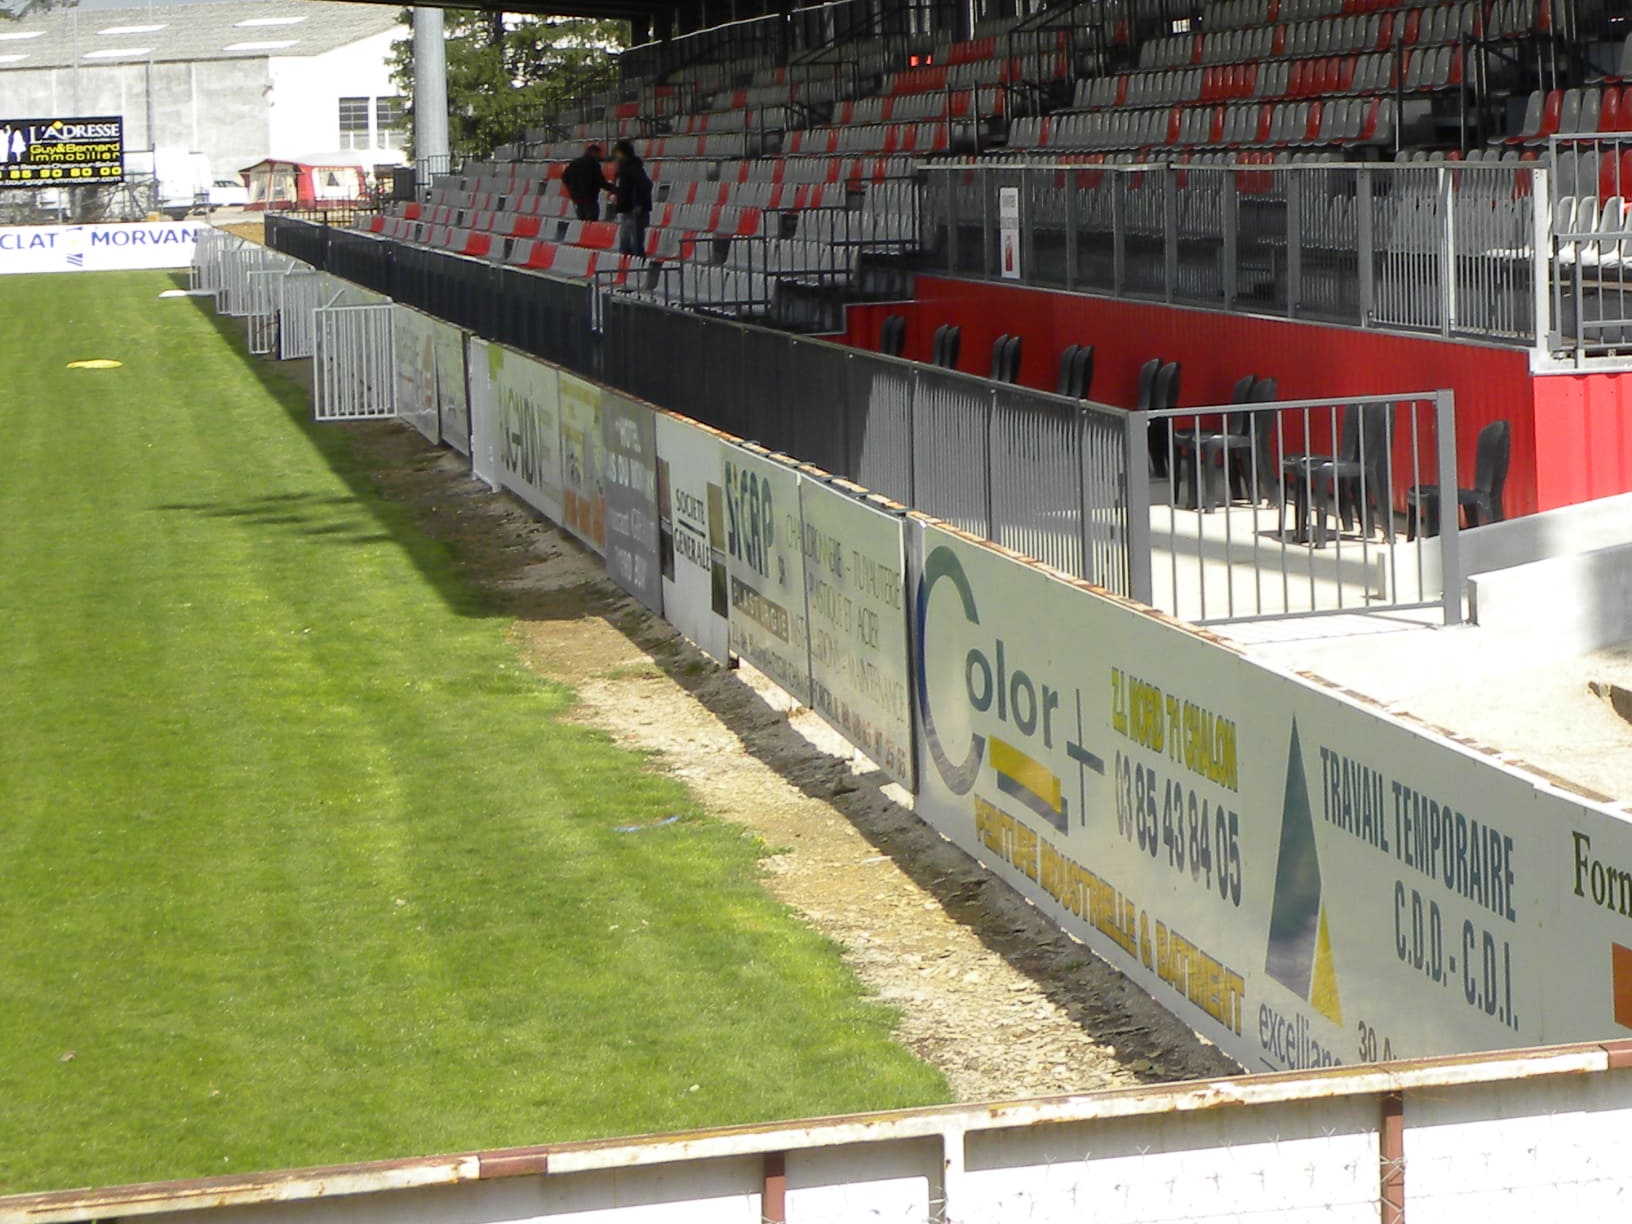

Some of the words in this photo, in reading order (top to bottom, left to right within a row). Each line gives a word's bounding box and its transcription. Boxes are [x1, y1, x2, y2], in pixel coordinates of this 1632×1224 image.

[30, 122, 120, 144] L'ADRESSE
[91, 228, 198, 247] MORVAN
[1129, 675, 1163, 754] NORD
[1166, 694, 1182, 764] 71
[1184, 699, 1239, 793] CHALON
[1115, 749, 1133, 842] 03
[1135, 762, 1158, 858] 85
[1163, 778, 1185, 873] 43
[1189, 789, 1211, 890] 84
[1215, 805, 1241, 907] 05
[1320, 745, 1389, 853] TRAVAIL
[1392, 779, 1516, 923] TEMPORAIRE
[975, 793, 1038, 882] PEINTURE
[1040, 836, 1138, 960] INDUSTRIELLE
[1156, 919, 1244, 1037] BATIMENT
[1463, 919, 1519, 1032] C.D.I.
